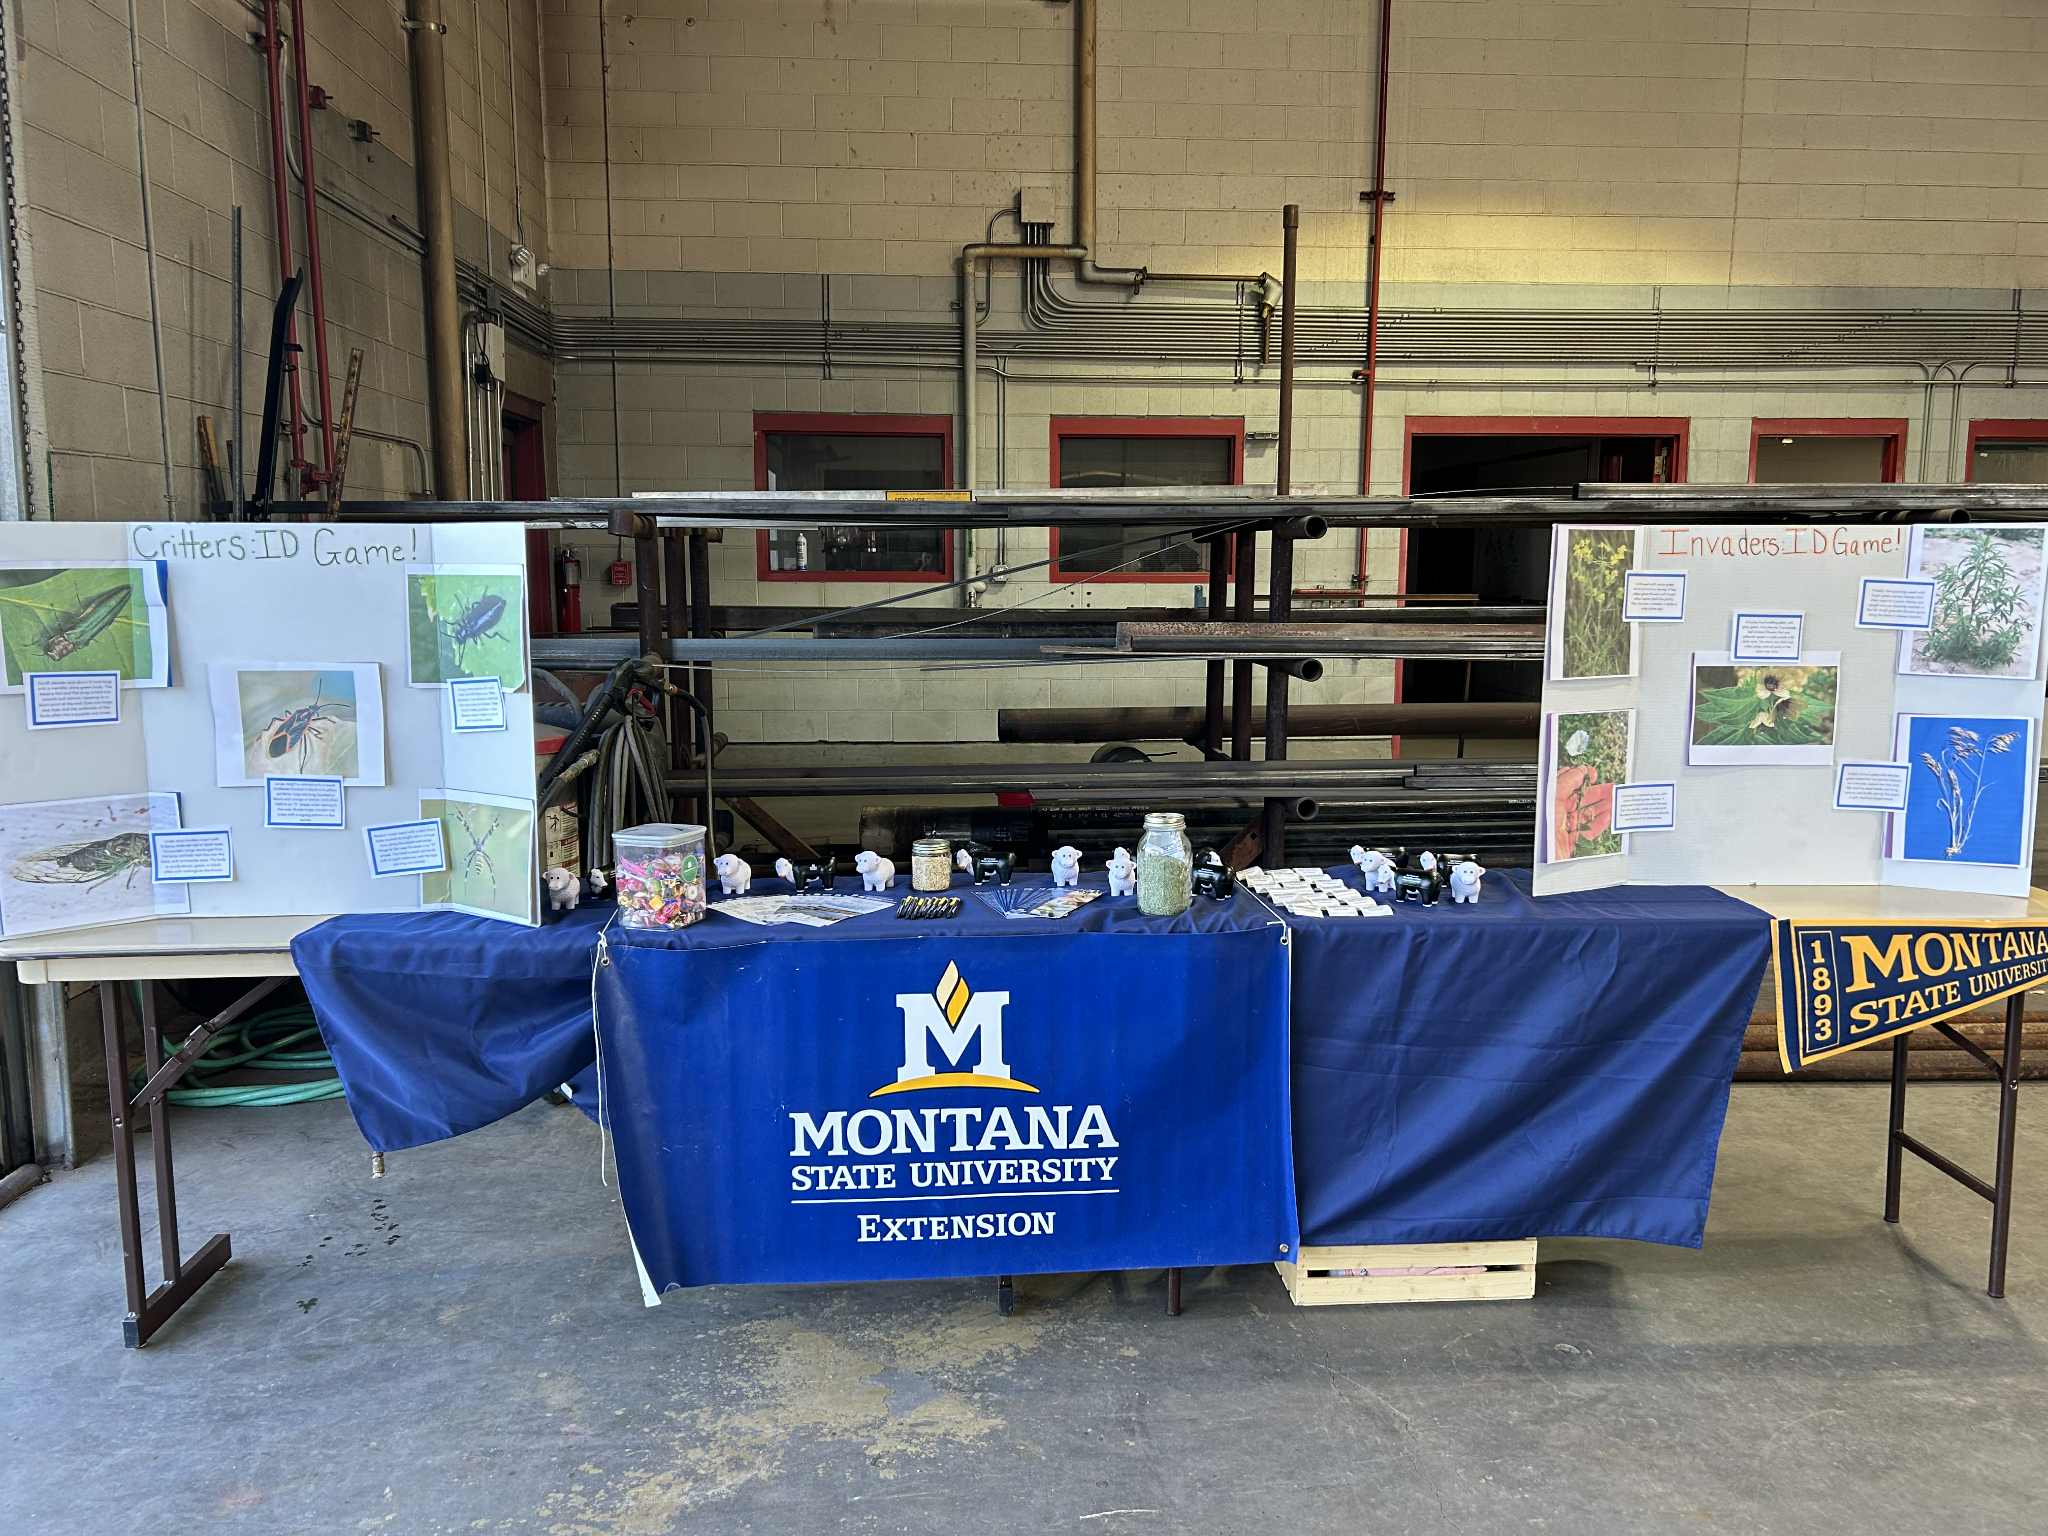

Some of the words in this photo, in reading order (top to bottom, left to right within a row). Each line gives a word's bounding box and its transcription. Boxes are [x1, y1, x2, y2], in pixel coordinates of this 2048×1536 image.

[314, 528, 416, 566] Game!
[1833, 527, 1901, 557] Game!
[1840, 930, 2048, 993] MONTANA
[1850, 981, 1961, 1034] STATE
[1968, 958, 2048, 996] UNIVERSIT
[789, 1105, 1119, 1157] MONTANA
[791, 1163, 896, 1191] STATE
[910, 1157, 1118, 1188] UNIVERSITY
[857, 1212, 1056, 1243] EXTENSION
